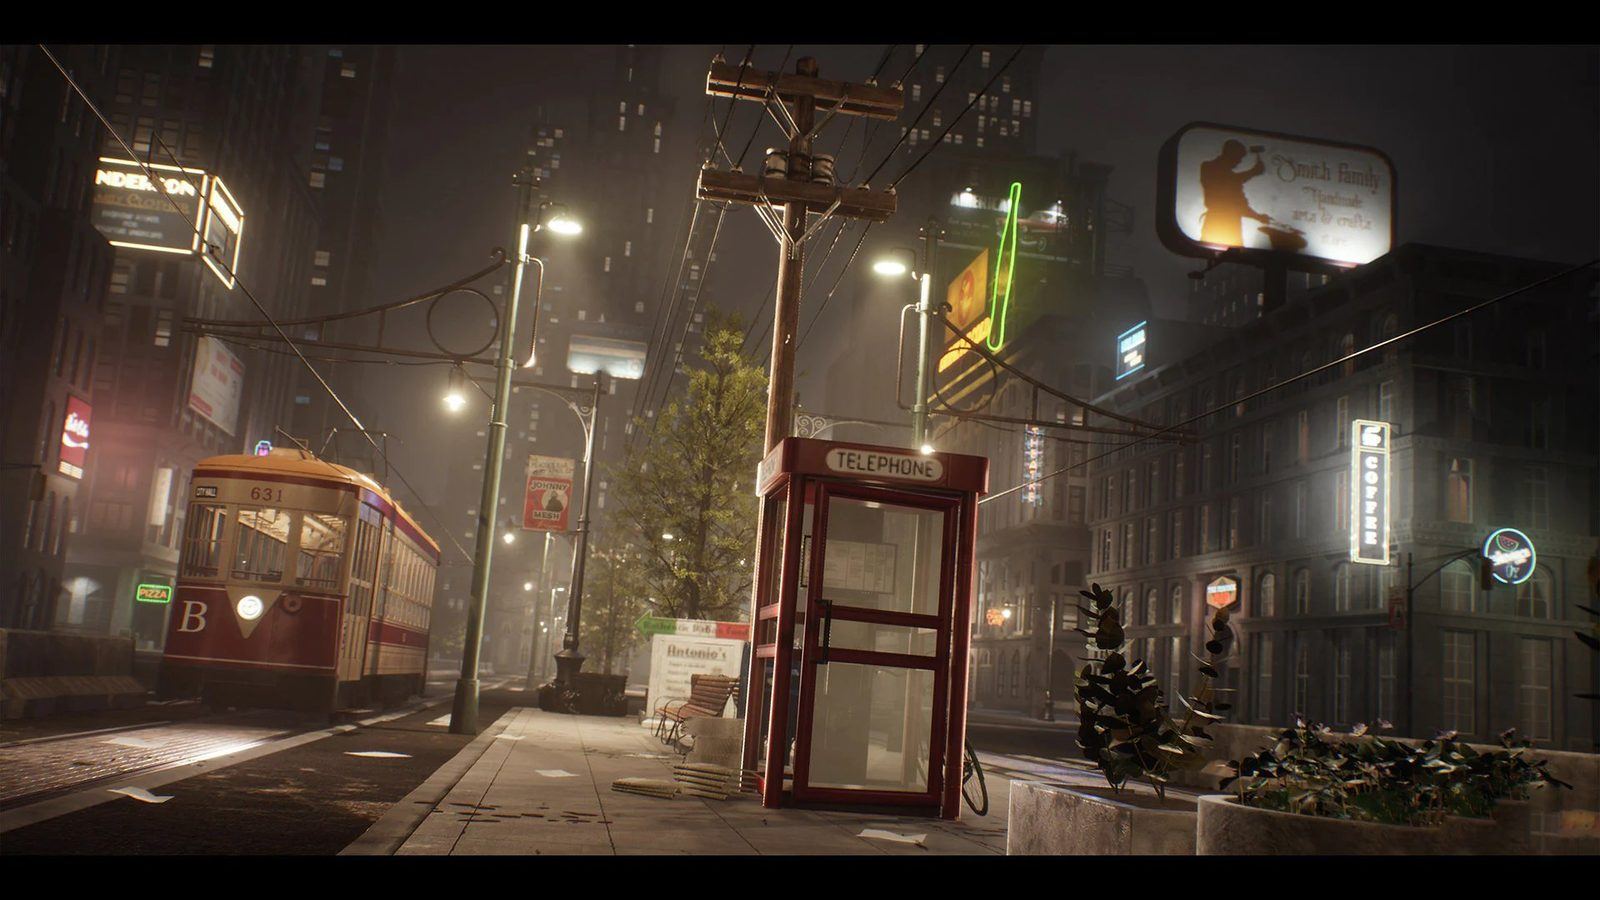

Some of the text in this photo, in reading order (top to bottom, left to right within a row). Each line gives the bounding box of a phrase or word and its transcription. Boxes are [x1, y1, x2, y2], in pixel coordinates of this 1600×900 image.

[1271, 153, 1331, 183] Smith
[95, 169, 196, 197] NDERON
[836, 451, 934, 478] TELEPHONE
[251, 487, 282, 502] 631
[531, 480, 570, 491] JOHNNY
[1364, 455, 1379, 545] COFFEE
[533, 510, 560, 520] MESH
[140, 588, 167, 599] PIZZA
[177, 600, 208, 633] B
[667, 644, 727, 660] Antonio's
